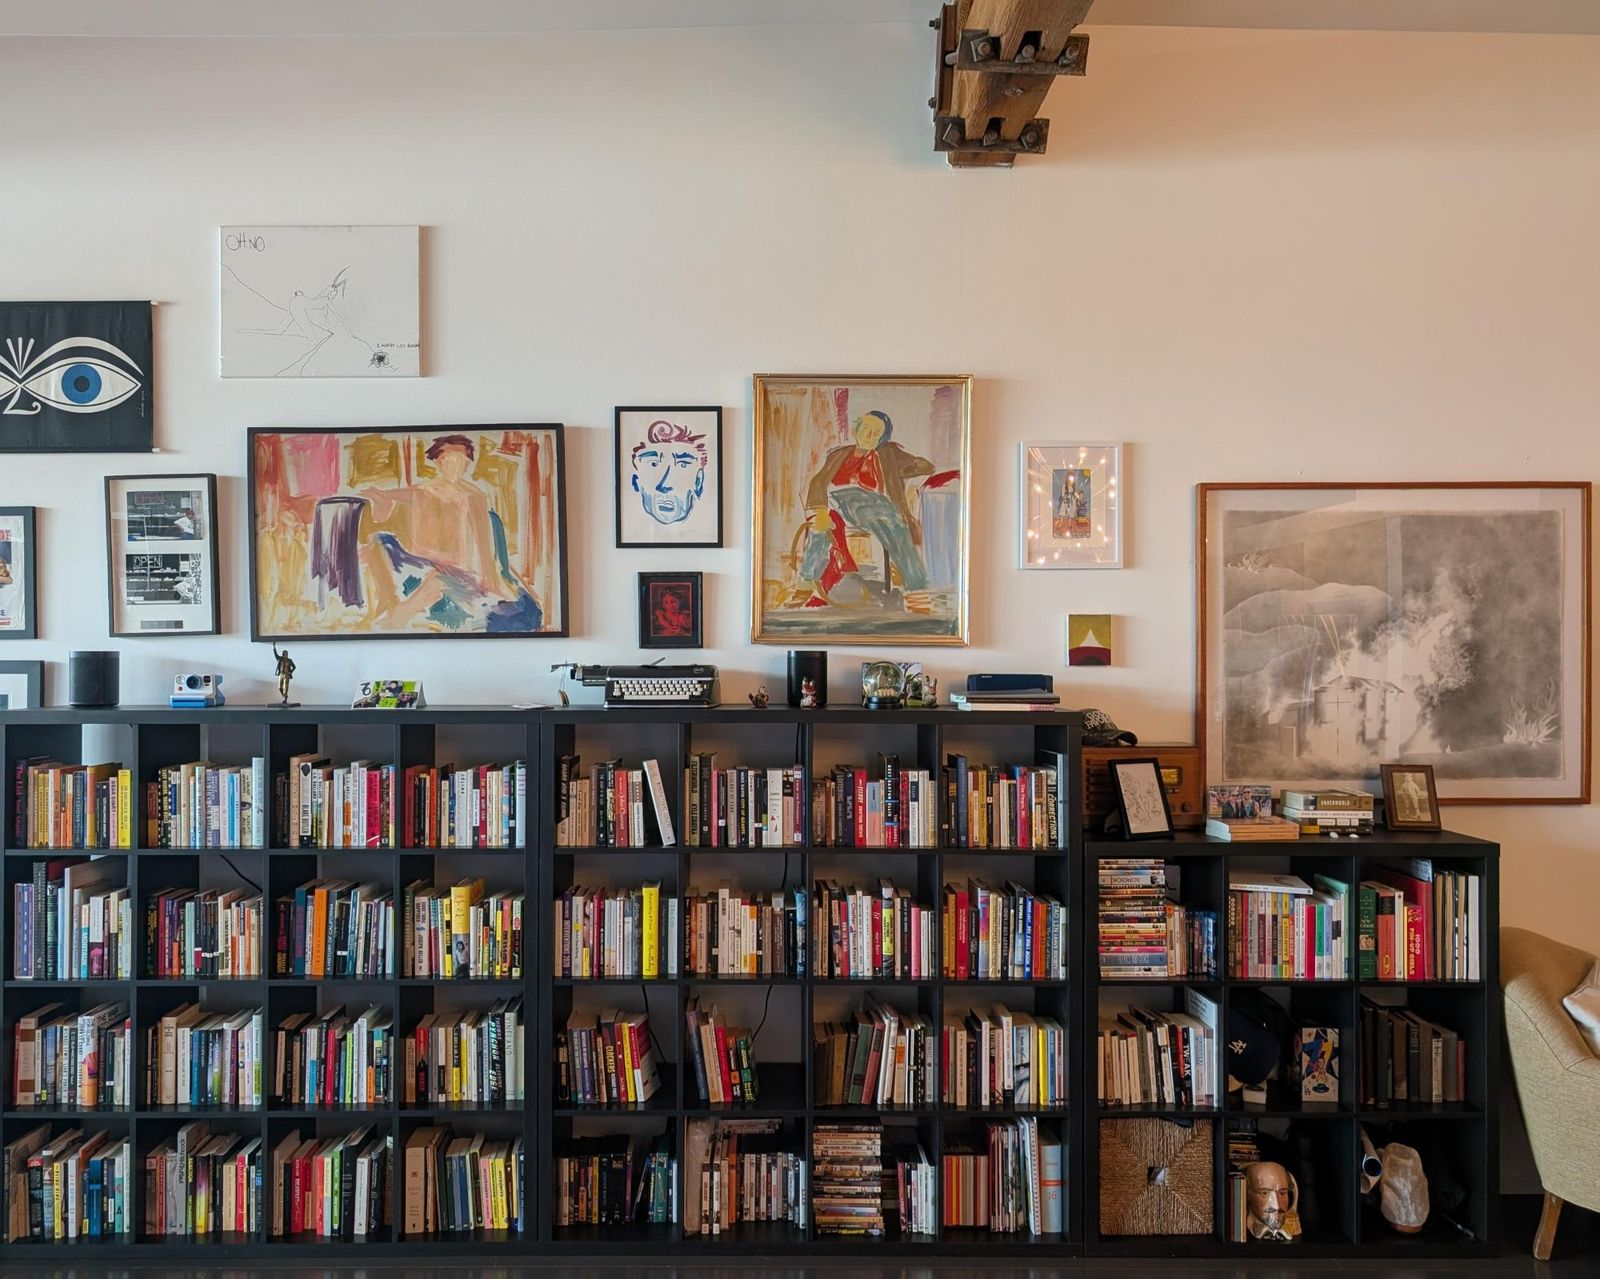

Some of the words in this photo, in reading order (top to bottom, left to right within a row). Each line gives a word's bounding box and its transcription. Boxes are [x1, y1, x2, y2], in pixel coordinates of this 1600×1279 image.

[226, 232, 246, 251] OH
[249, 236, 266, 252] NO
[134, 556, 162, 568] OPEN
[16, 767, 24, 779] The
[1048, 794, 1057, 839] CORRECTIONS
[328, 936, 332, 944] OF
[489, 1021, 500, 1061] PYNCHON
[605, 1045, 615, 1074] CLOCKERS
[1183, 1045, 1191, 1077] TWEAK
[489, 1070, 497, 1091] EDGE
